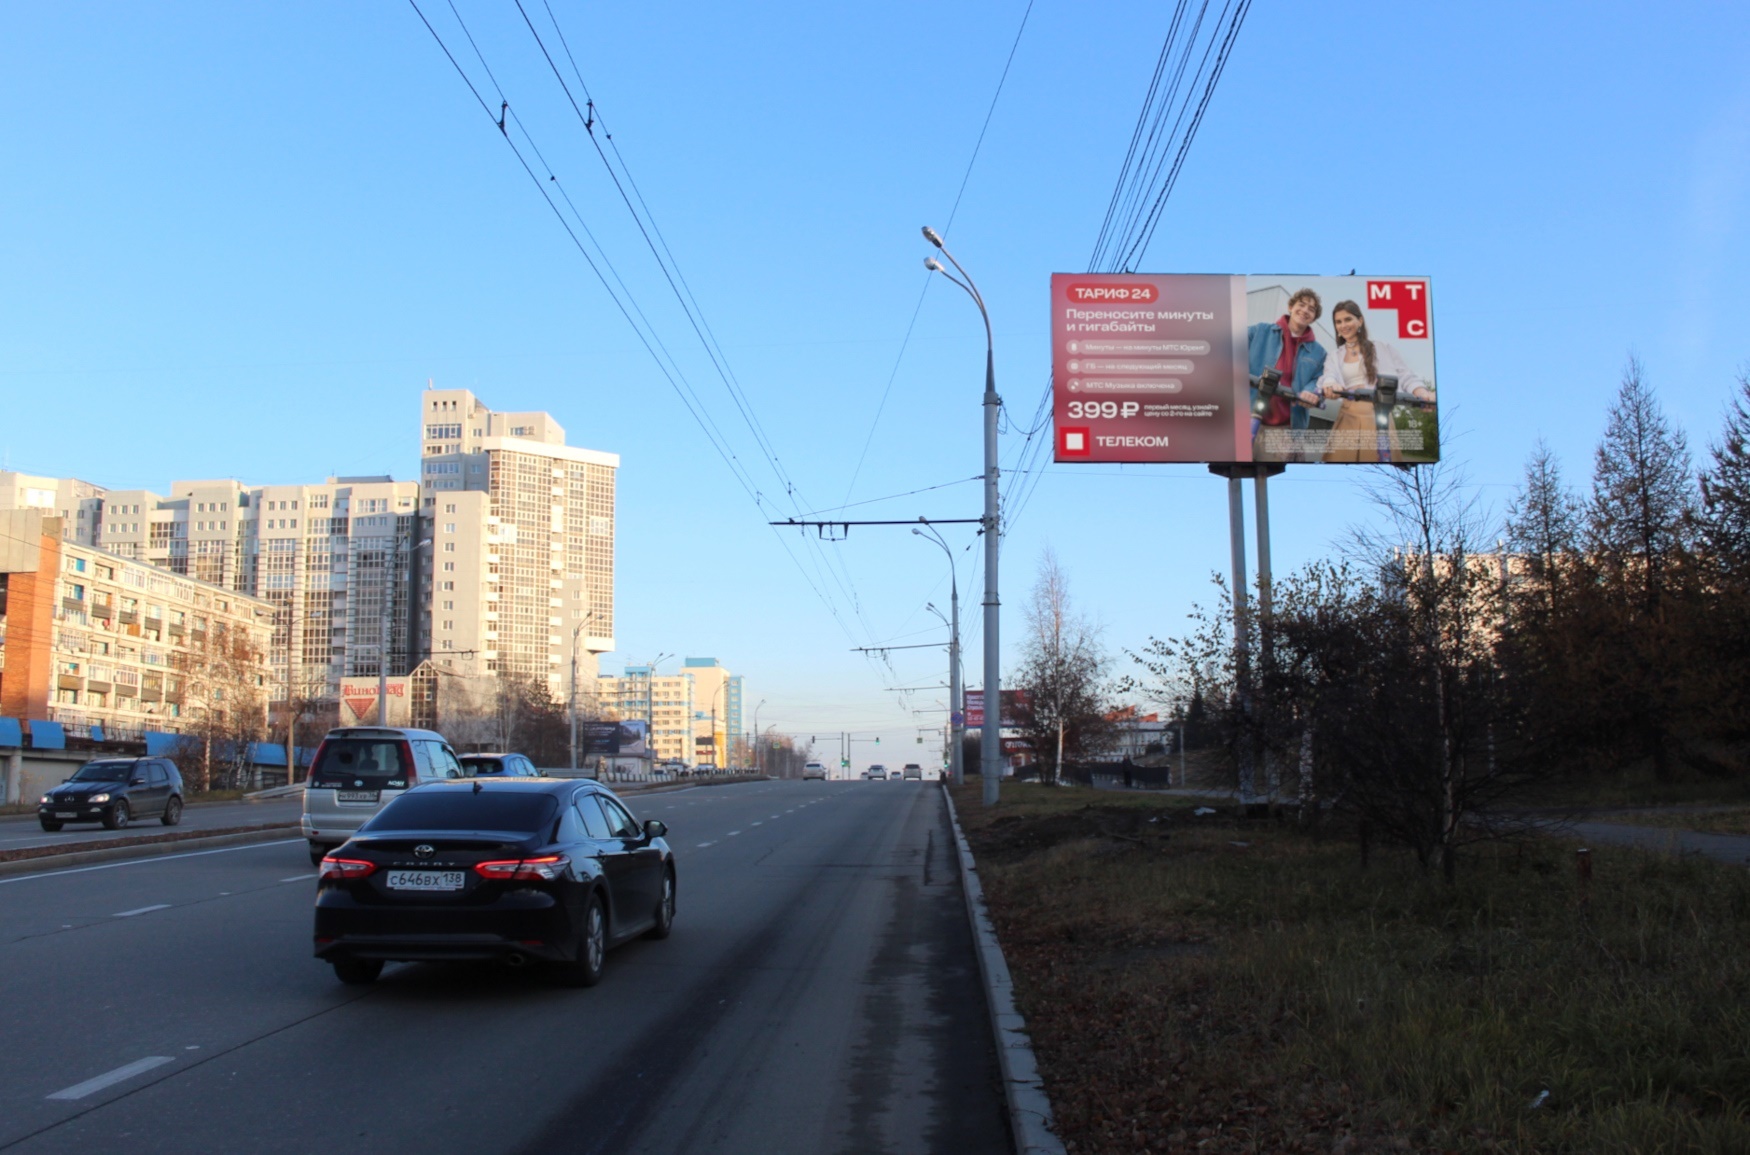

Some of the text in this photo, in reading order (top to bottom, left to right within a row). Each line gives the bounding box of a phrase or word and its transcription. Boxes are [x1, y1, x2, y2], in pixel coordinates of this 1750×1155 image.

[1075, 288, 1150, 299] ТАРИФ 24
[1067, 309, 1213, 322] Переносите минуты
[1079, 321, 1155, 332] гигабайты
[1096, 437, 1169, 447] ТЕЛЕКОМ
